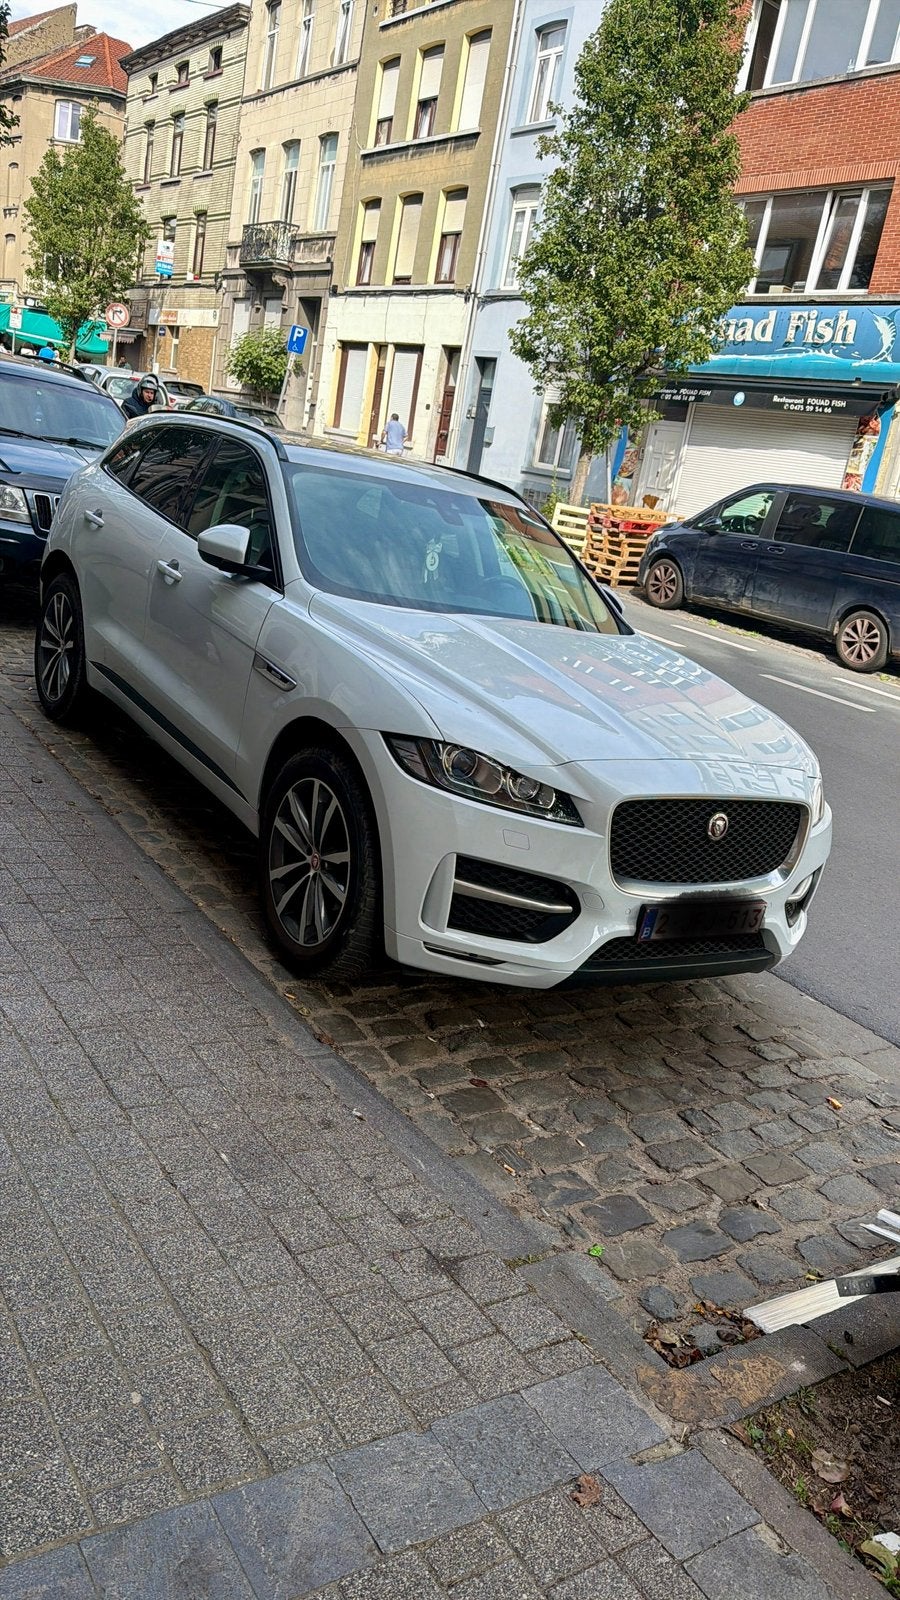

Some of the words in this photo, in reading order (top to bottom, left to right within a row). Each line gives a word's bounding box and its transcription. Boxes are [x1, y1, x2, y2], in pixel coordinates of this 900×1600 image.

[700, 309, 777, 342] uad
[784, 309, 857, 345] Fish
[293, 327, 304, 342] P
[679, 388, 698, 396] FOUAD
[698, 389, 712, 397] FISH
[772, 395, 805, 404] Restaurant
[807, 398, 830, 406] FOUAD
[831, 400, 847, 408] FISH
[641, 927, 651, 938] B
